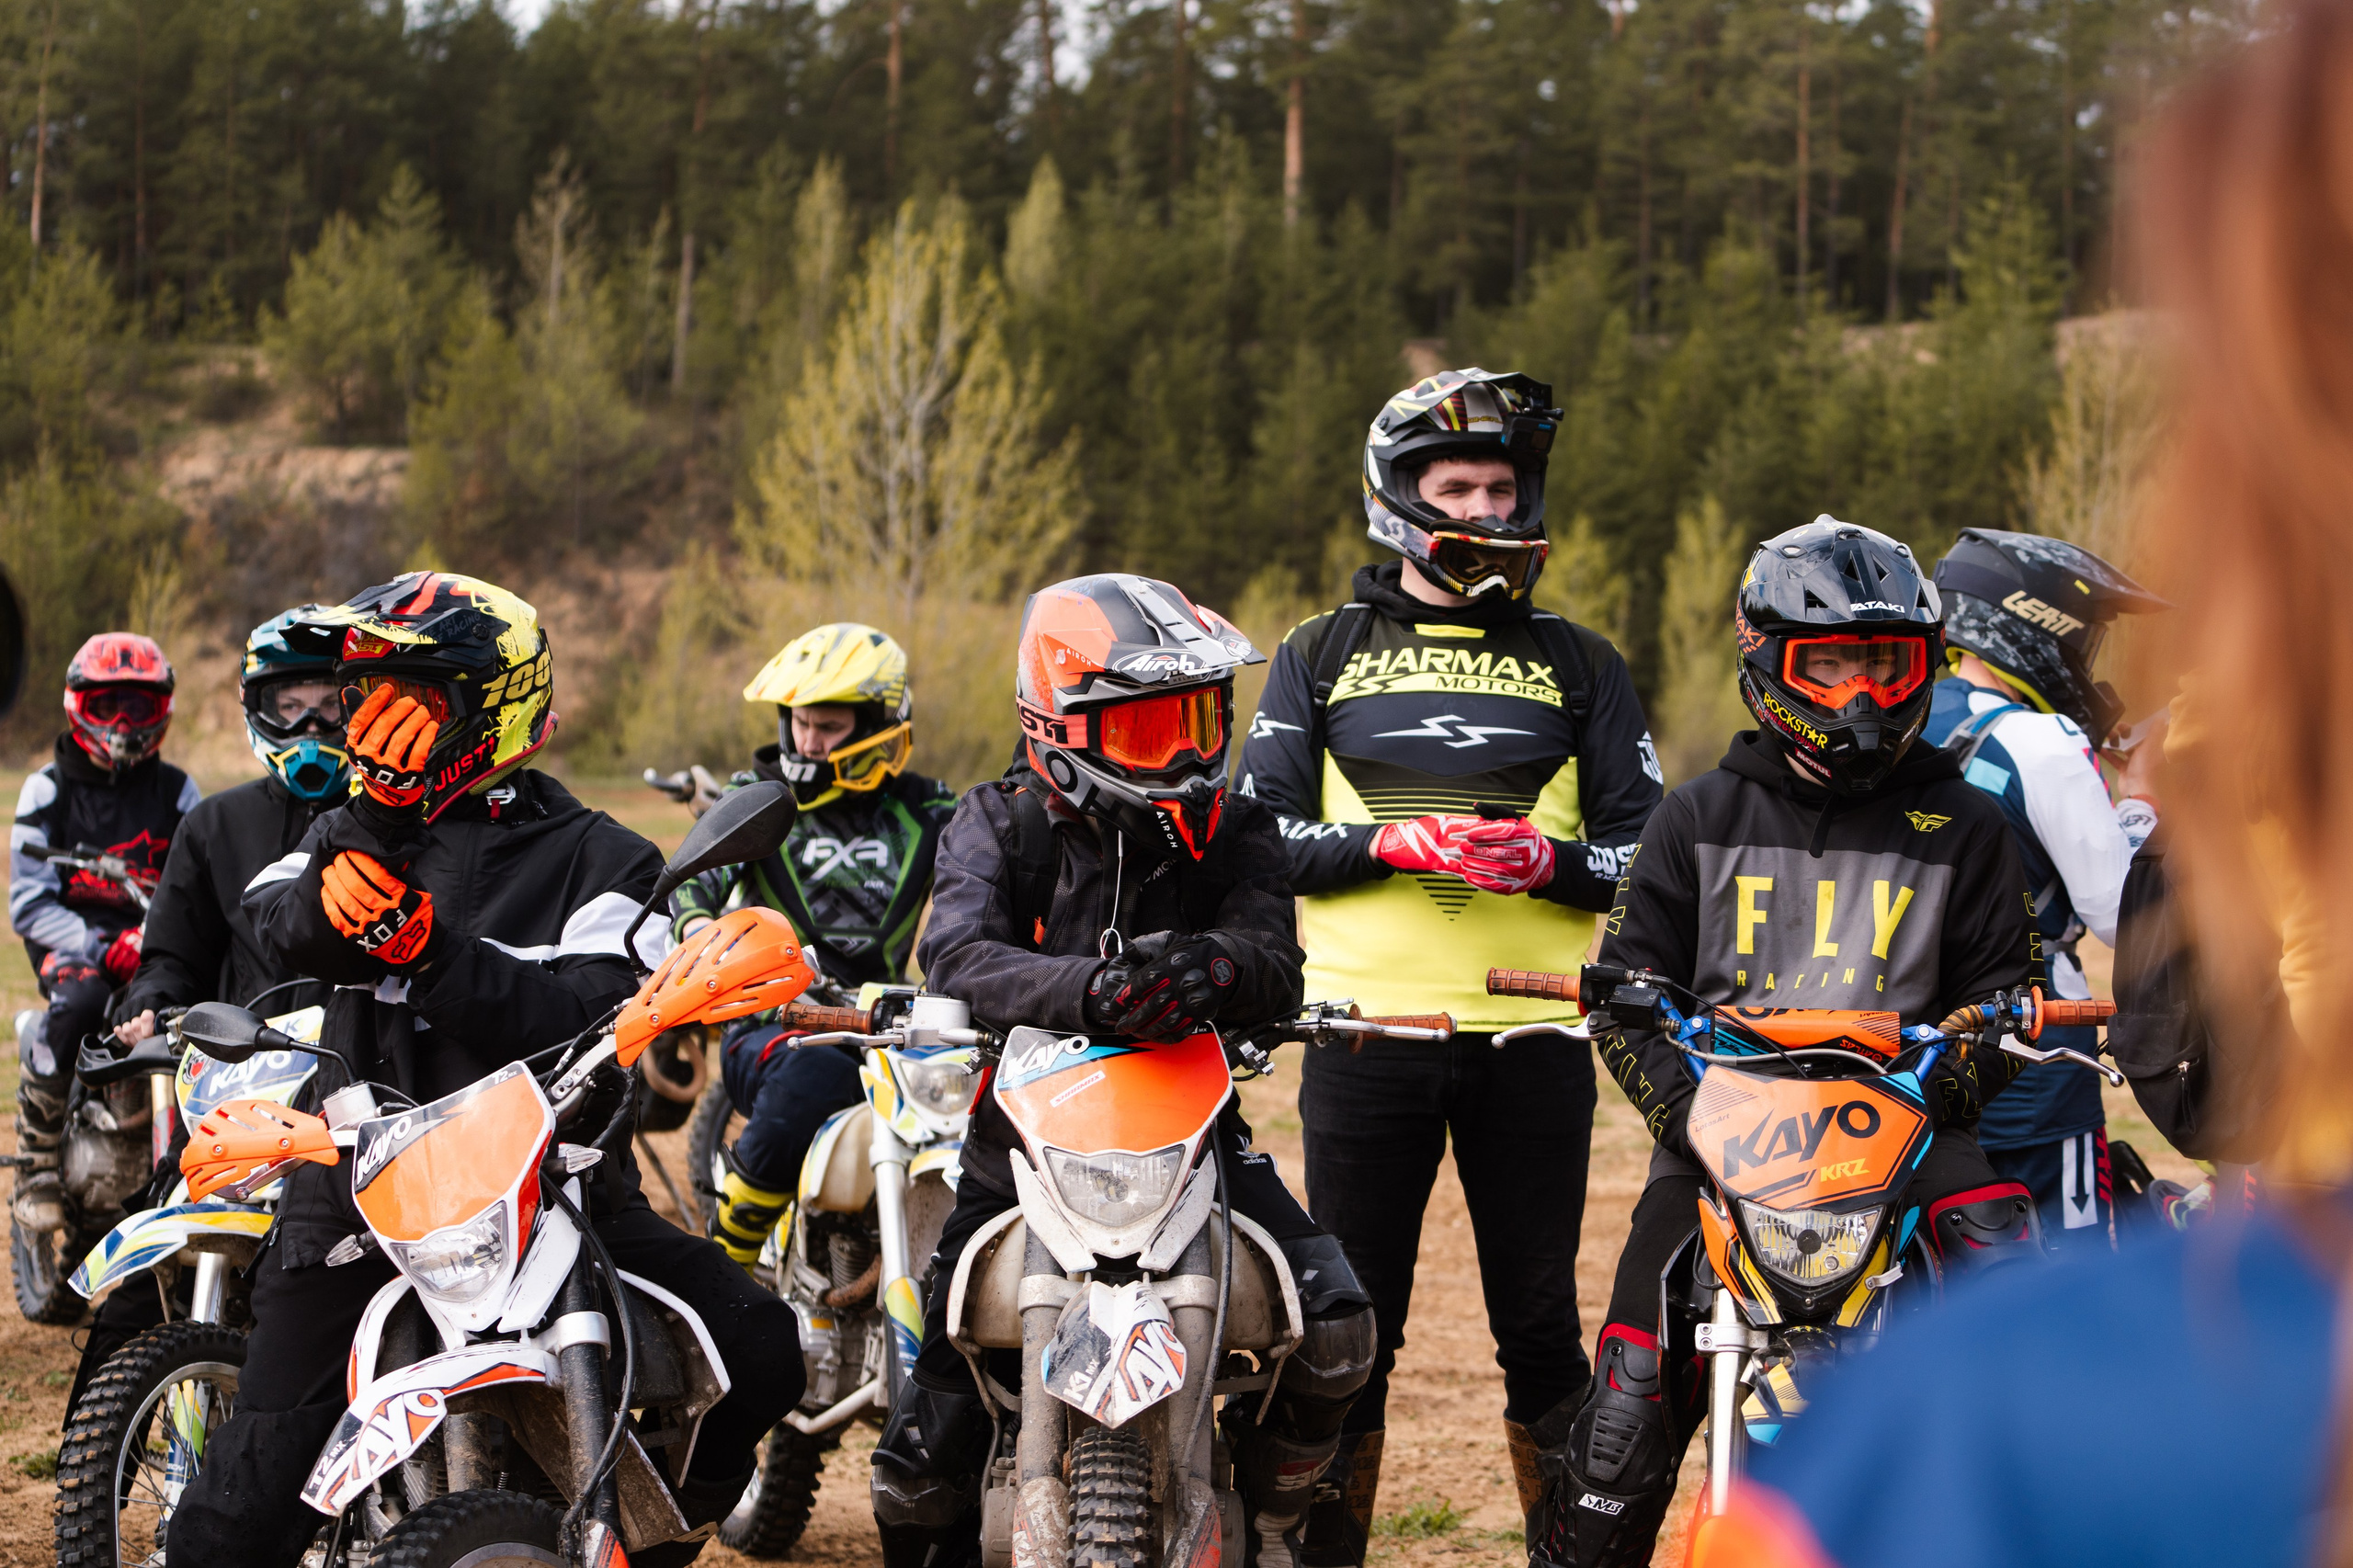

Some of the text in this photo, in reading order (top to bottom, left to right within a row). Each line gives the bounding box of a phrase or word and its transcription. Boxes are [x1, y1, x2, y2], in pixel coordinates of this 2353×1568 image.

[1066, 647, 1092, 667] AIROH
[1123, 653, 1195, 672] Airoh
[1336, 646, 1557, 688] SHARMAX
[1435, 676, 1560, 703] MOTORS
[1764, 708, 1793, 734] ENERGY
[1794, 733, 1819, 754] DRINK
[356, 759, 417, 790] FOX
[434, 737, 494, 792] JUST1
[1795, 749, 1832, 778] MOTUL
[1155, 811, 1178, 848] AIROH
[356, 908, 409, 953] FOX
[1735, 876, 1915, 960] FLY
[1736, 968, 1885, 993] RACING
[1003, 1035, 1090, 1085] KAYO
[1694, 1113, 1731, 1133] LotosArt
[356, 1115, 413, 1186] KAYO
[1722, 1100, 1881, 1181] KAYO
[1819, 1157, 1870, 1183] KRZ
